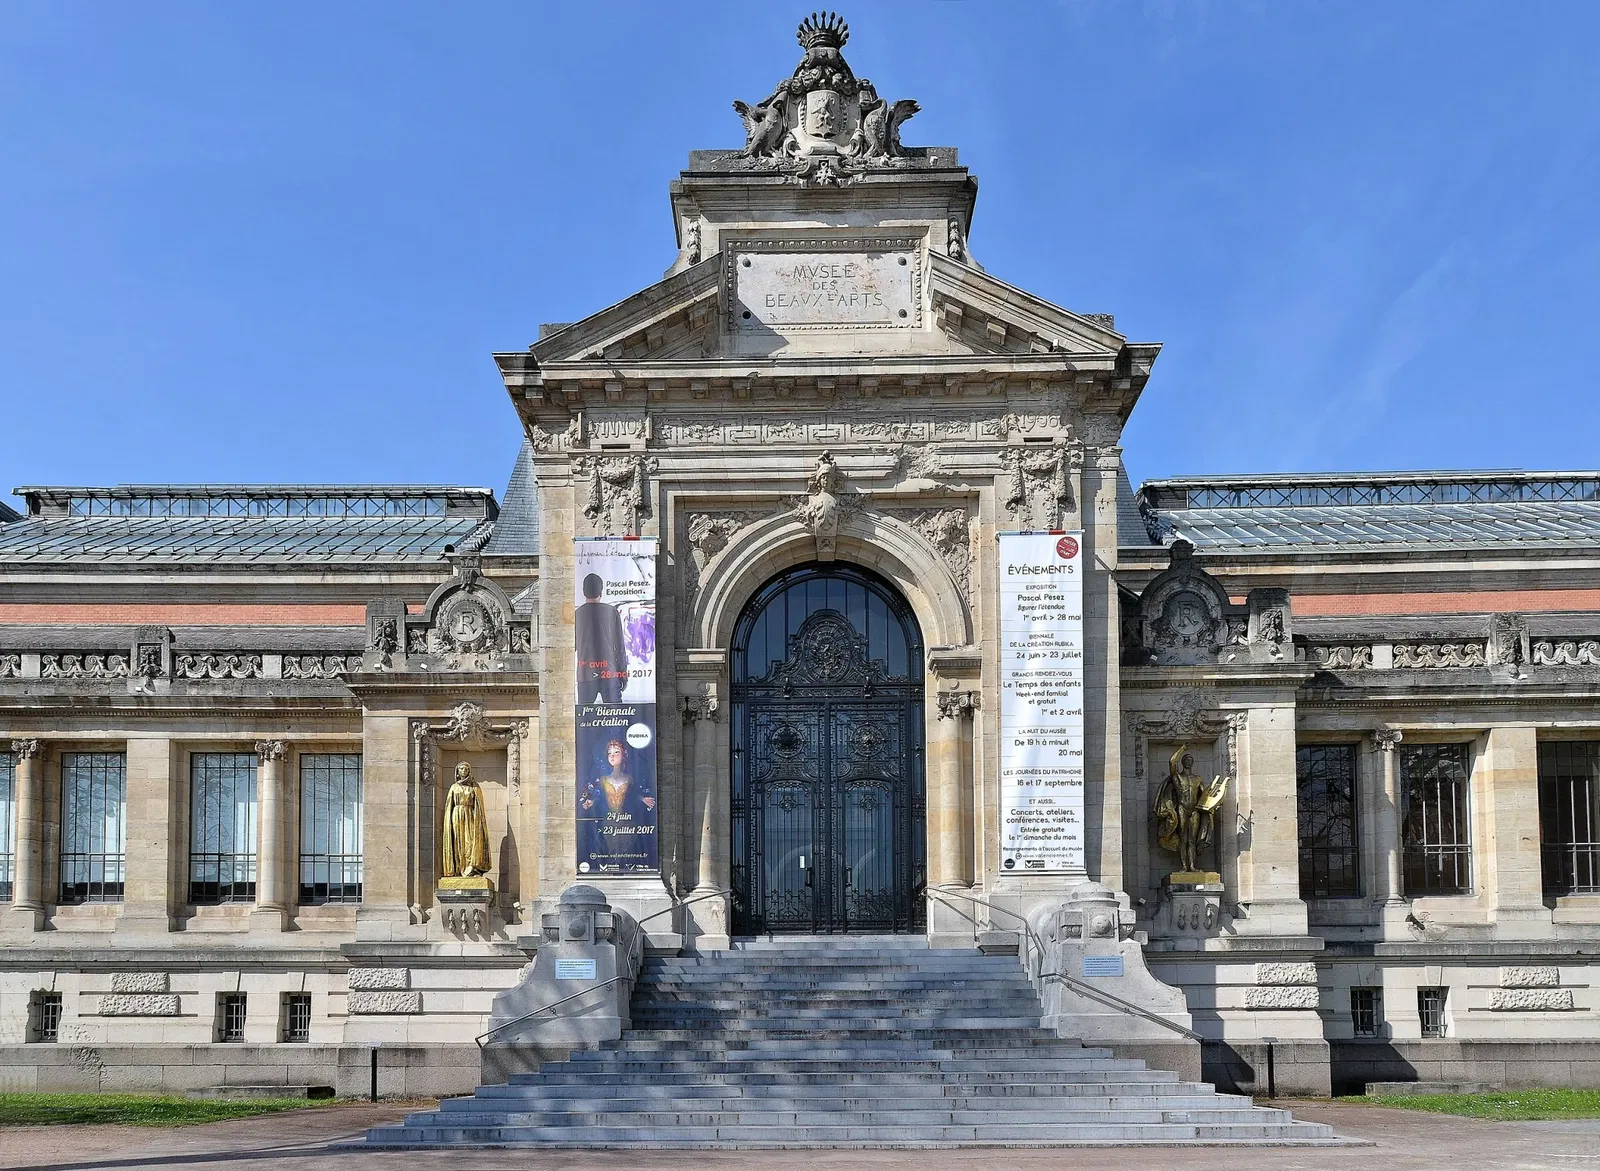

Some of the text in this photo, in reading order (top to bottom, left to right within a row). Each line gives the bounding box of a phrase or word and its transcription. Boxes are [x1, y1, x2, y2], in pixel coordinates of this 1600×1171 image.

[812, 281, 837, 290] DES
[1007, 564, 1074, 575] ÉVÉNEMENTS
[606, 580, 627, 588] Pascal
[1031, 613, 1048, 621] avril
[1177, 600, 1200, 628] R
[456, 608, 478, 635] R
[1028, 652, 1041, 660] juin
[1049, 651, 1059, 659] 23
[1061, 651, 1082, 660] juillet
[589, 659, 608, 668] avril
[601, 671, 611, 679] 28
[612, 670, 630, 678] mai
[632, 670, 653, 678] 2017
[1014, 680, 1038, 689] Temps
[595, 706, 637, 717] Biennale
[1066, 708, 1082, 716] avril
[592, 716, 629, 727] création
[1044, 779, 1083, 788] septembre
[1010, 808, 1075, 816] Concerts, ateliers,
[606, 812, 632, 822] 24 juin
[1006, 816, 1051, 824] conférences,
[603, 826, 614, 834] 23
[613, 826, 636, 836] juillet
[636, 825, 655, 834] 2017
